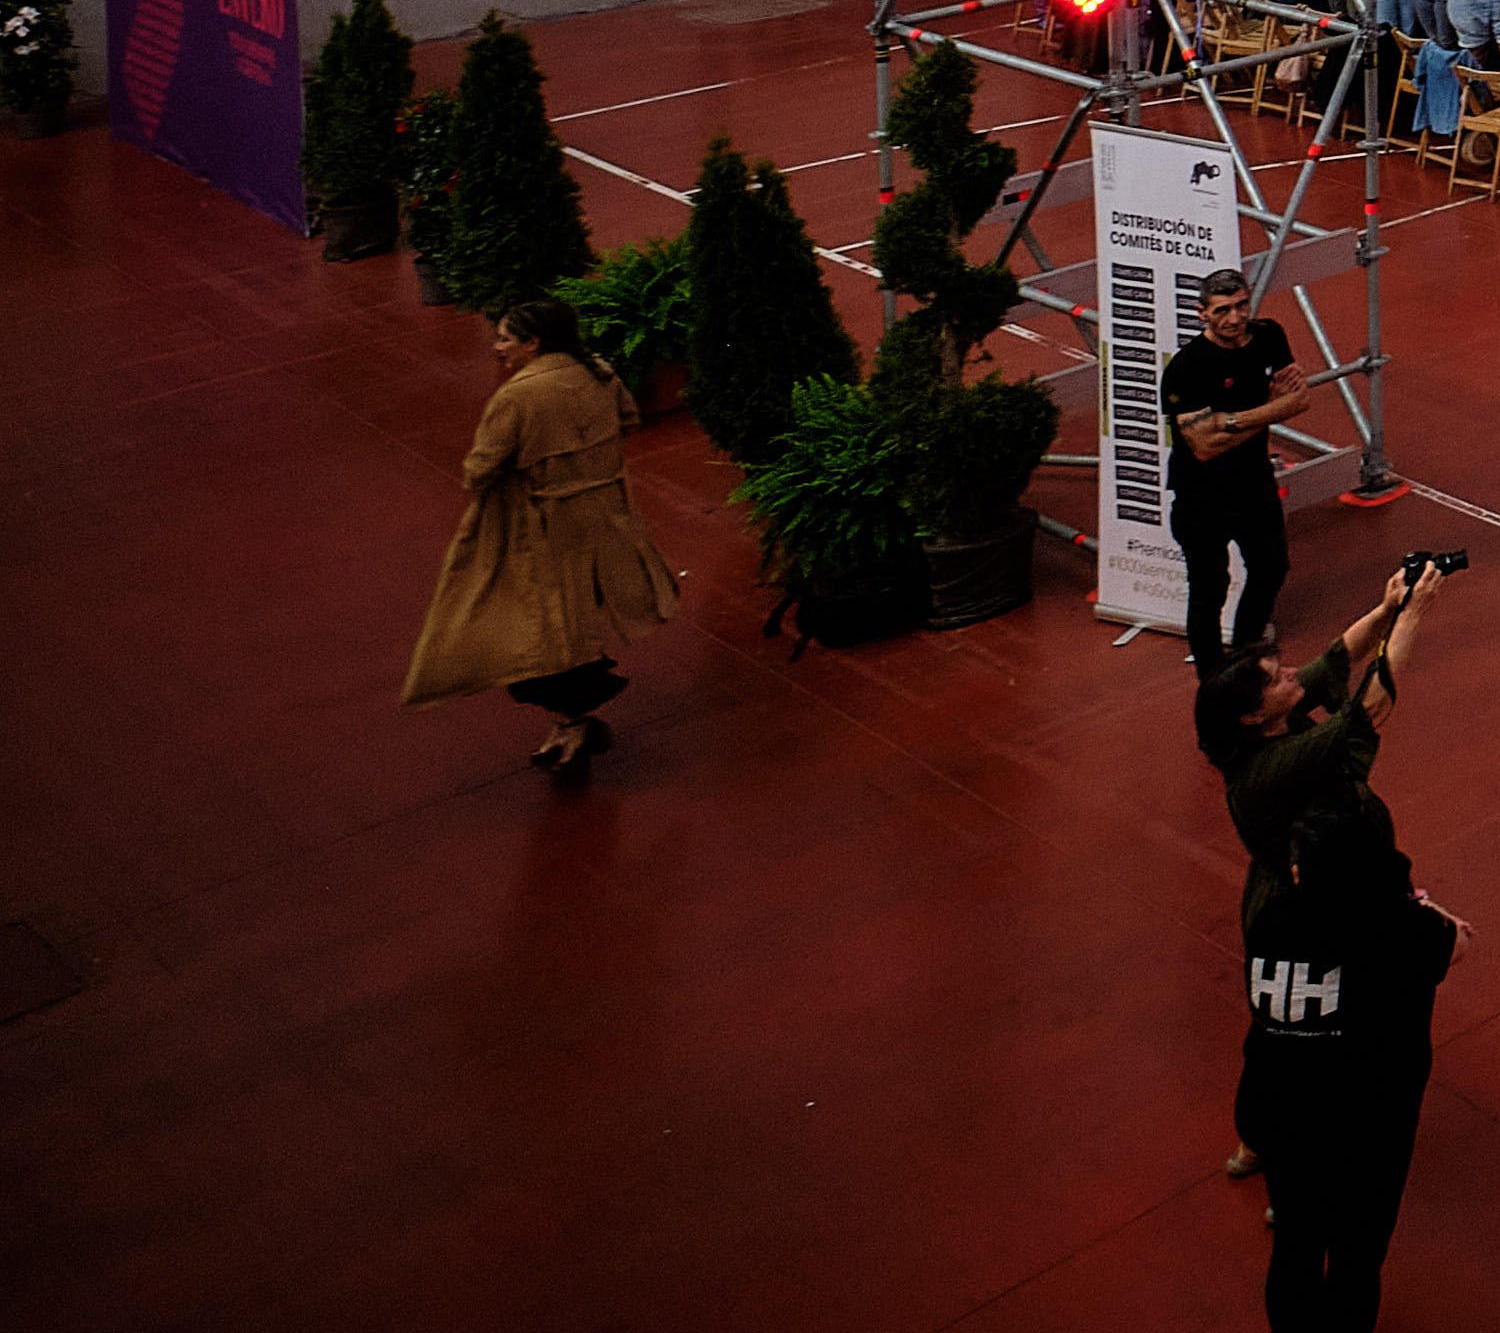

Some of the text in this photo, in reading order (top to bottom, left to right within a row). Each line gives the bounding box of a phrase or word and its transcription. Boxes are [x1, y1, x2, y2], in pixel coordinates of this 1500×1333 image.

[1112, 211, 1213, 241] DISTRIBUCIÓN DE
[1110, 231, 1215, 262] COMITÉS DE CATA
[1251, 957, 1341, 1023] HH
